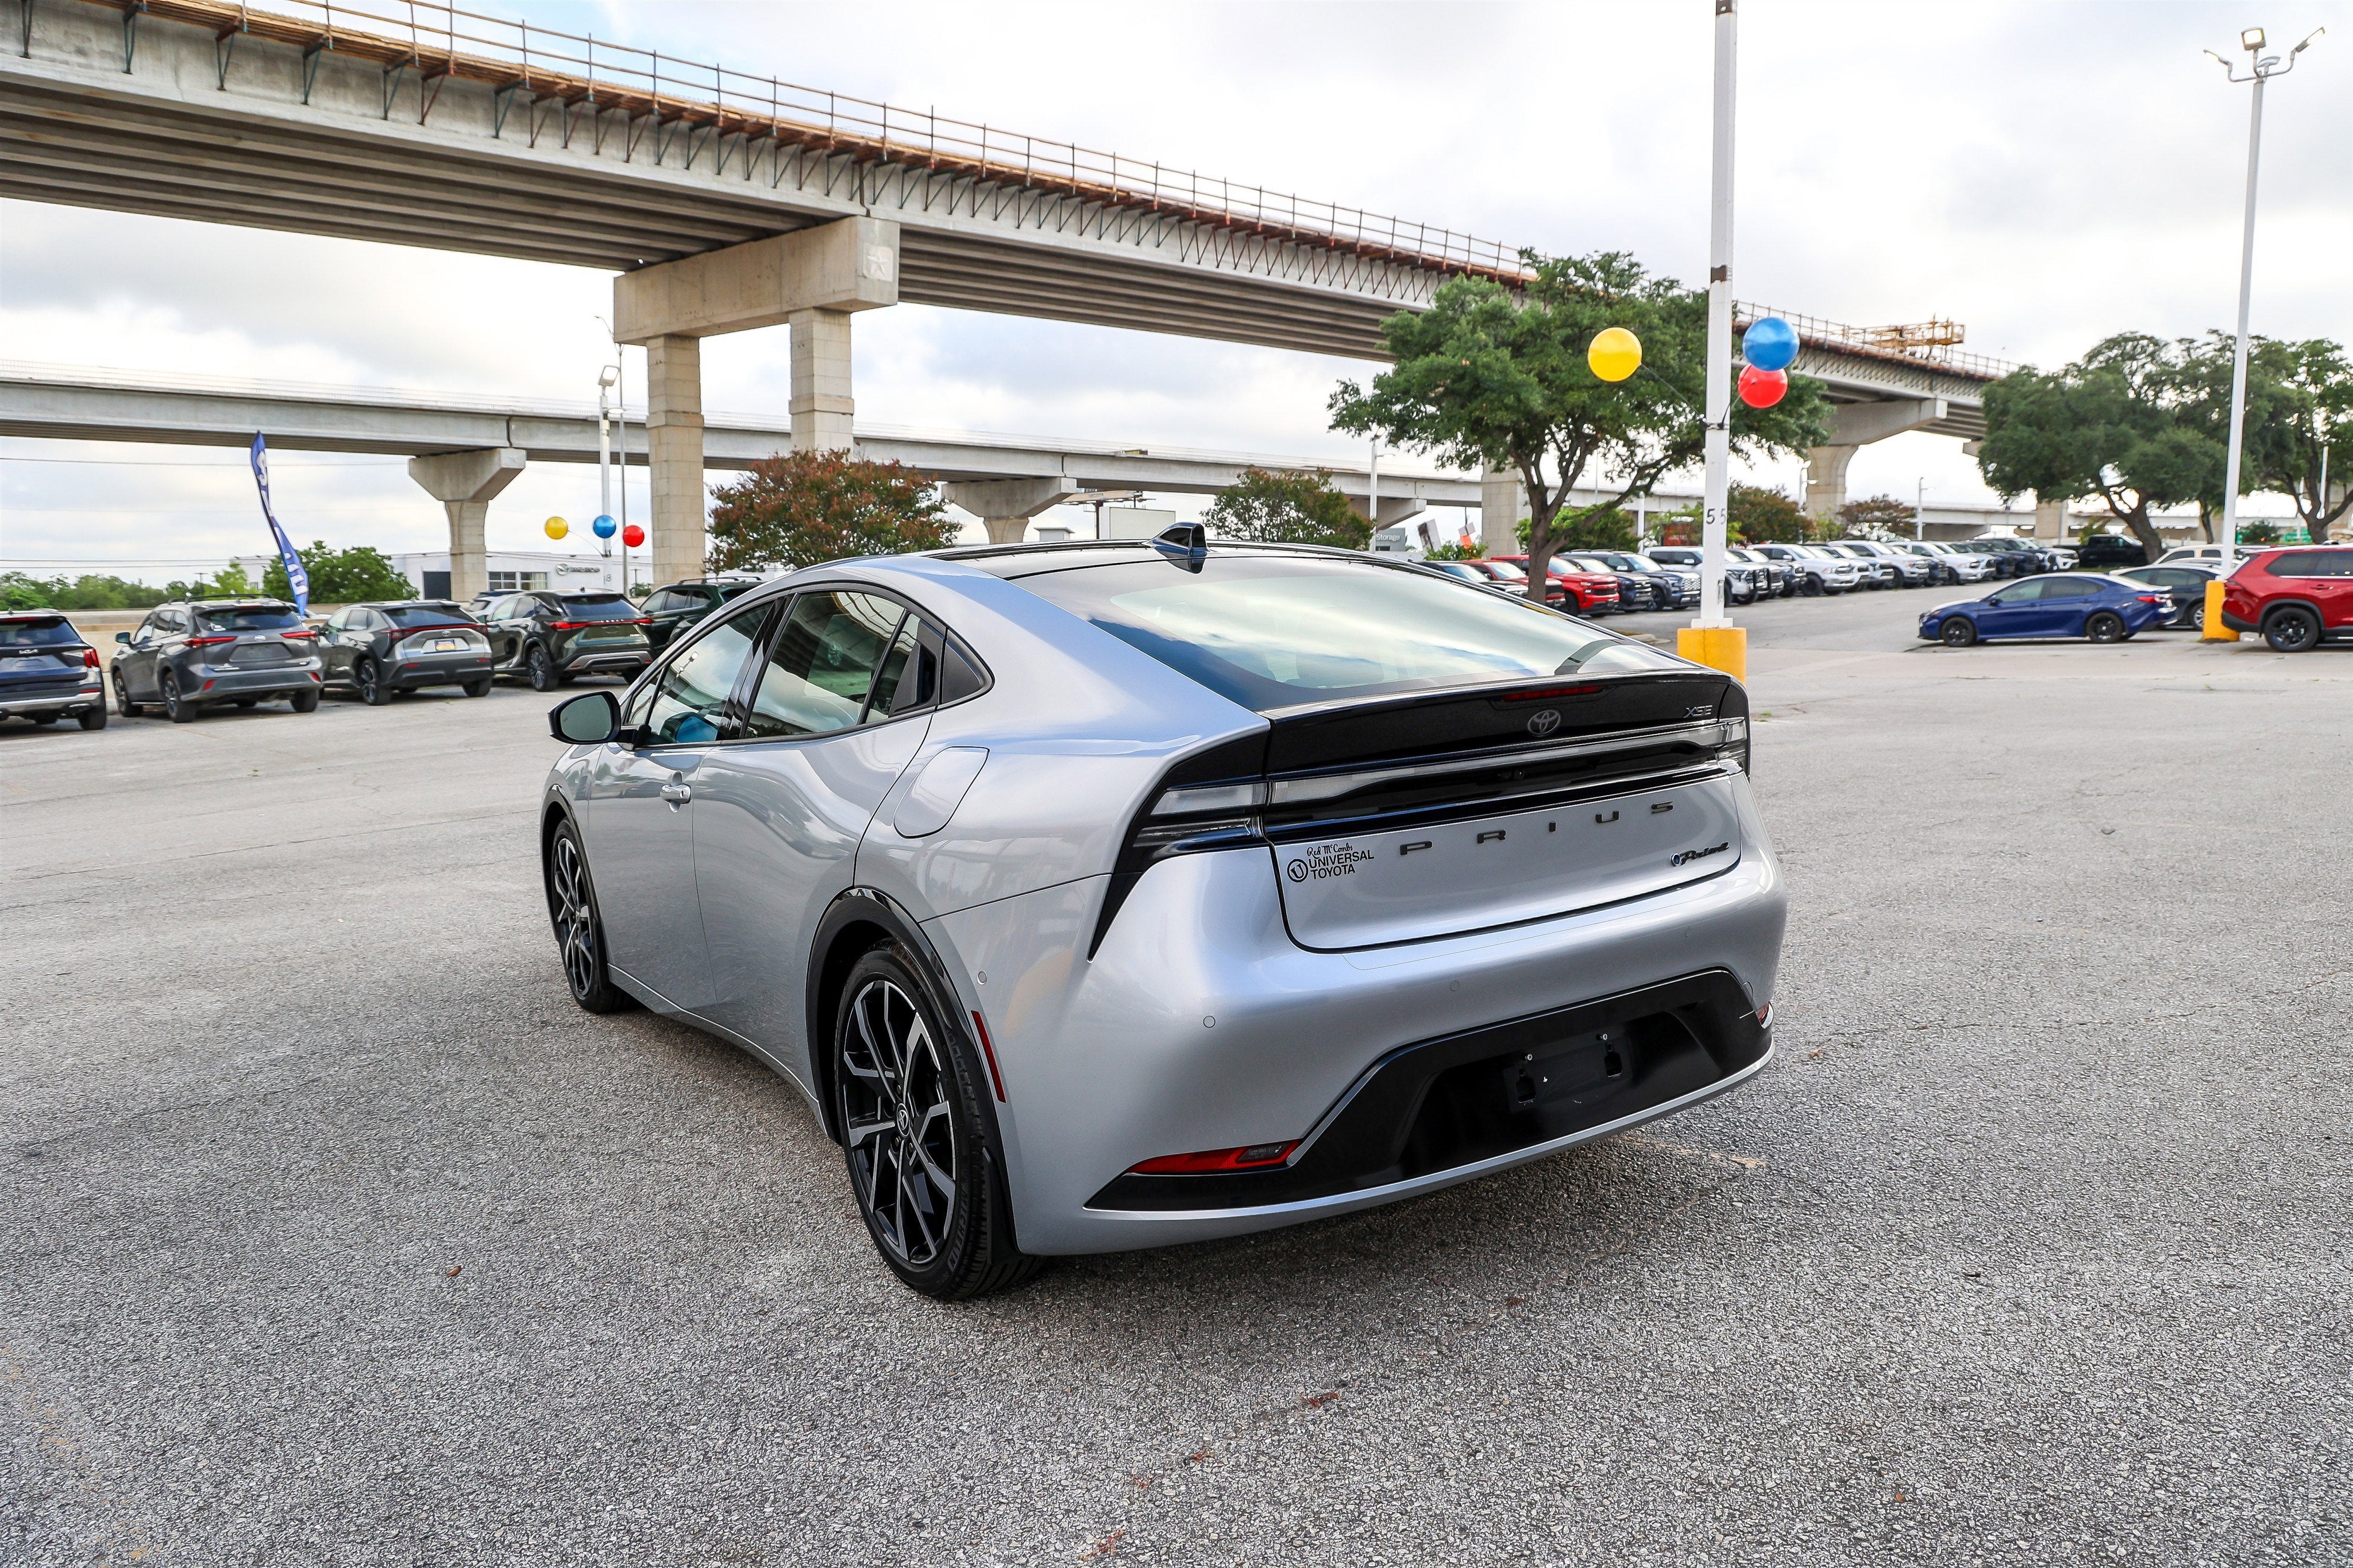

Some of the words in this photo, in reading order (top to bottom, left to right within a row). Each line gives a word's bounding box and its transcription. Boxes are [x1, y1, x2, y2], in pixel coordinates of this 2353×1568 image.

[1683, 705, 1712, 718] XSE
[1399, 801, 1674, 855] PRIUS
[1307, 845, 1321, 859] Red
[1308, 849, 1375, 868] UNIVERSAL
[1310, 863, 1356, 880] TOYOTA
